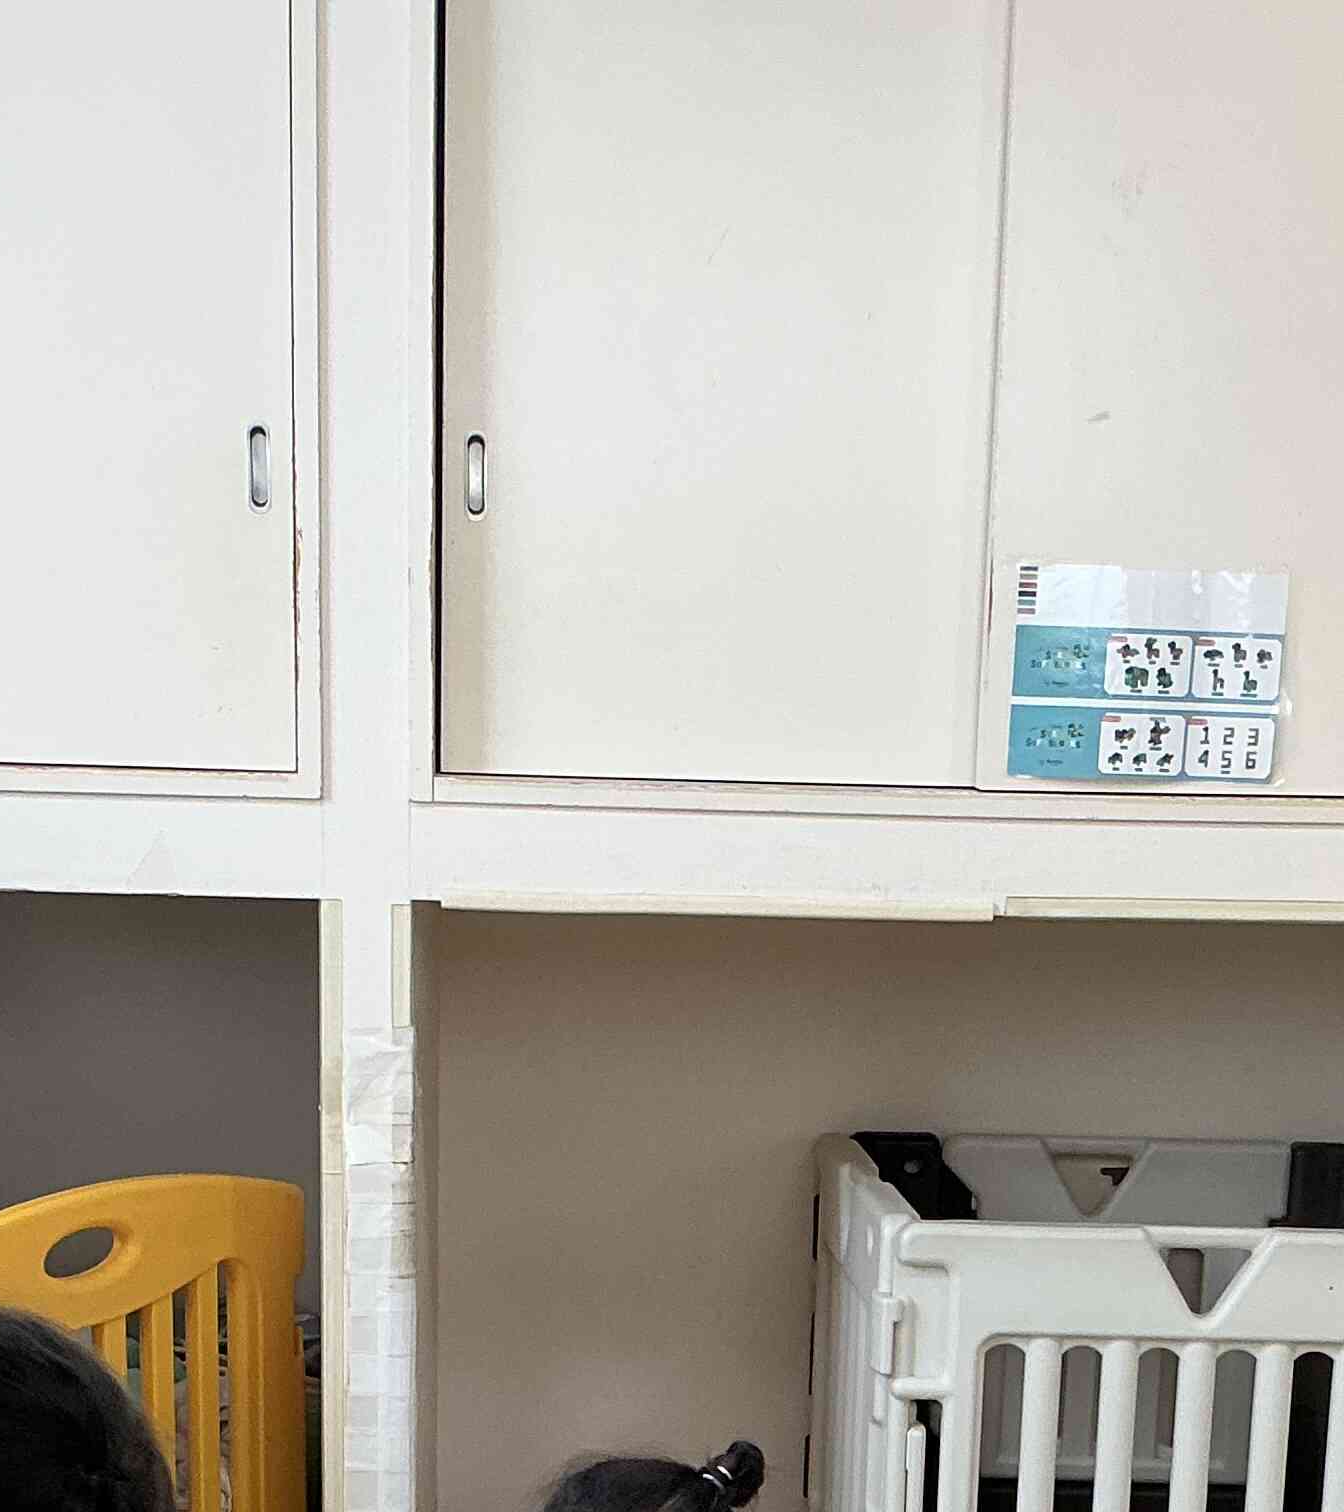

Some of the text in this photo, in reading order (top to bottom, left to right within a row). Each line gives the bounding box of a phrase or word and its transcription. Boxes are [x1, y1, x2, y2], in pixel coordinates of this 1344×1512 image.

[1199, 726, 1260, 747] 1 2 3
[1197, 749, 1258, 770] 4 5 6
